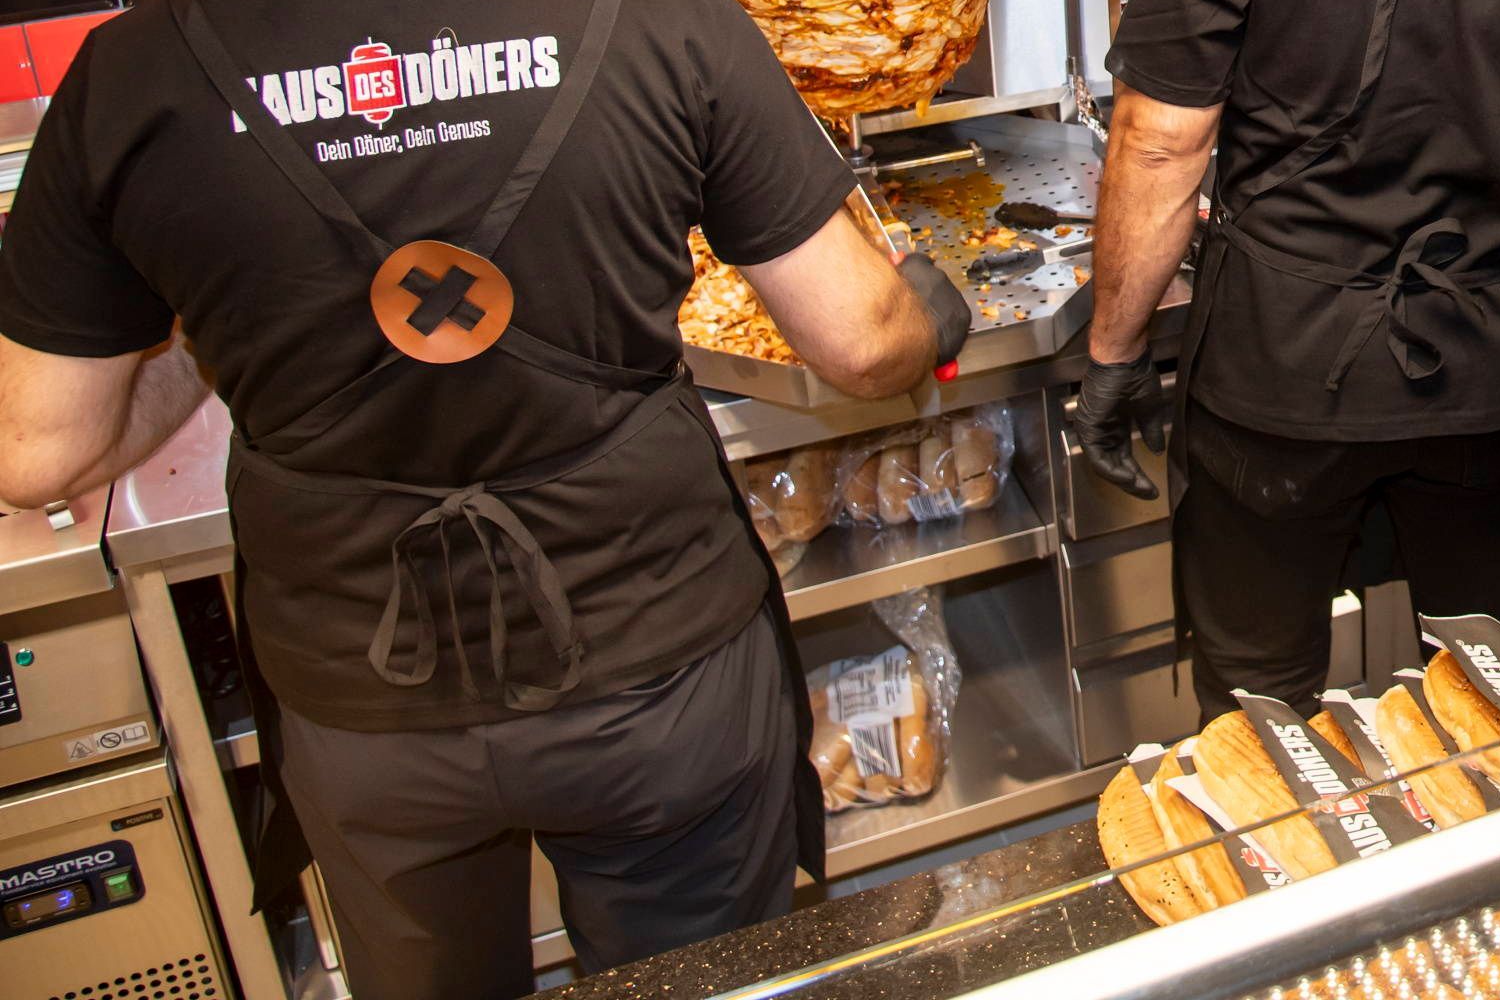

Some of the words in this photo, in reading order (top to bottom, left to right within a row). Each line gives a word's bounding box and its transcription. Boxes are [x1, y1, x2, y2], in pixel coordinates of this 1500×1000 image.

[355, 70, 397, 101] DES
[404, 36, 560, 106] DÖNERS
[316, 138, 353, 162] Dein
[353, 131, 403, 158] Döner,
[405, 126, 436, 149] Dein
[437, 119, 491, 142] Genuss
[1272, 724, 1349, 795] DÖNERS
[0, 850, 115, 890] MASTRO
